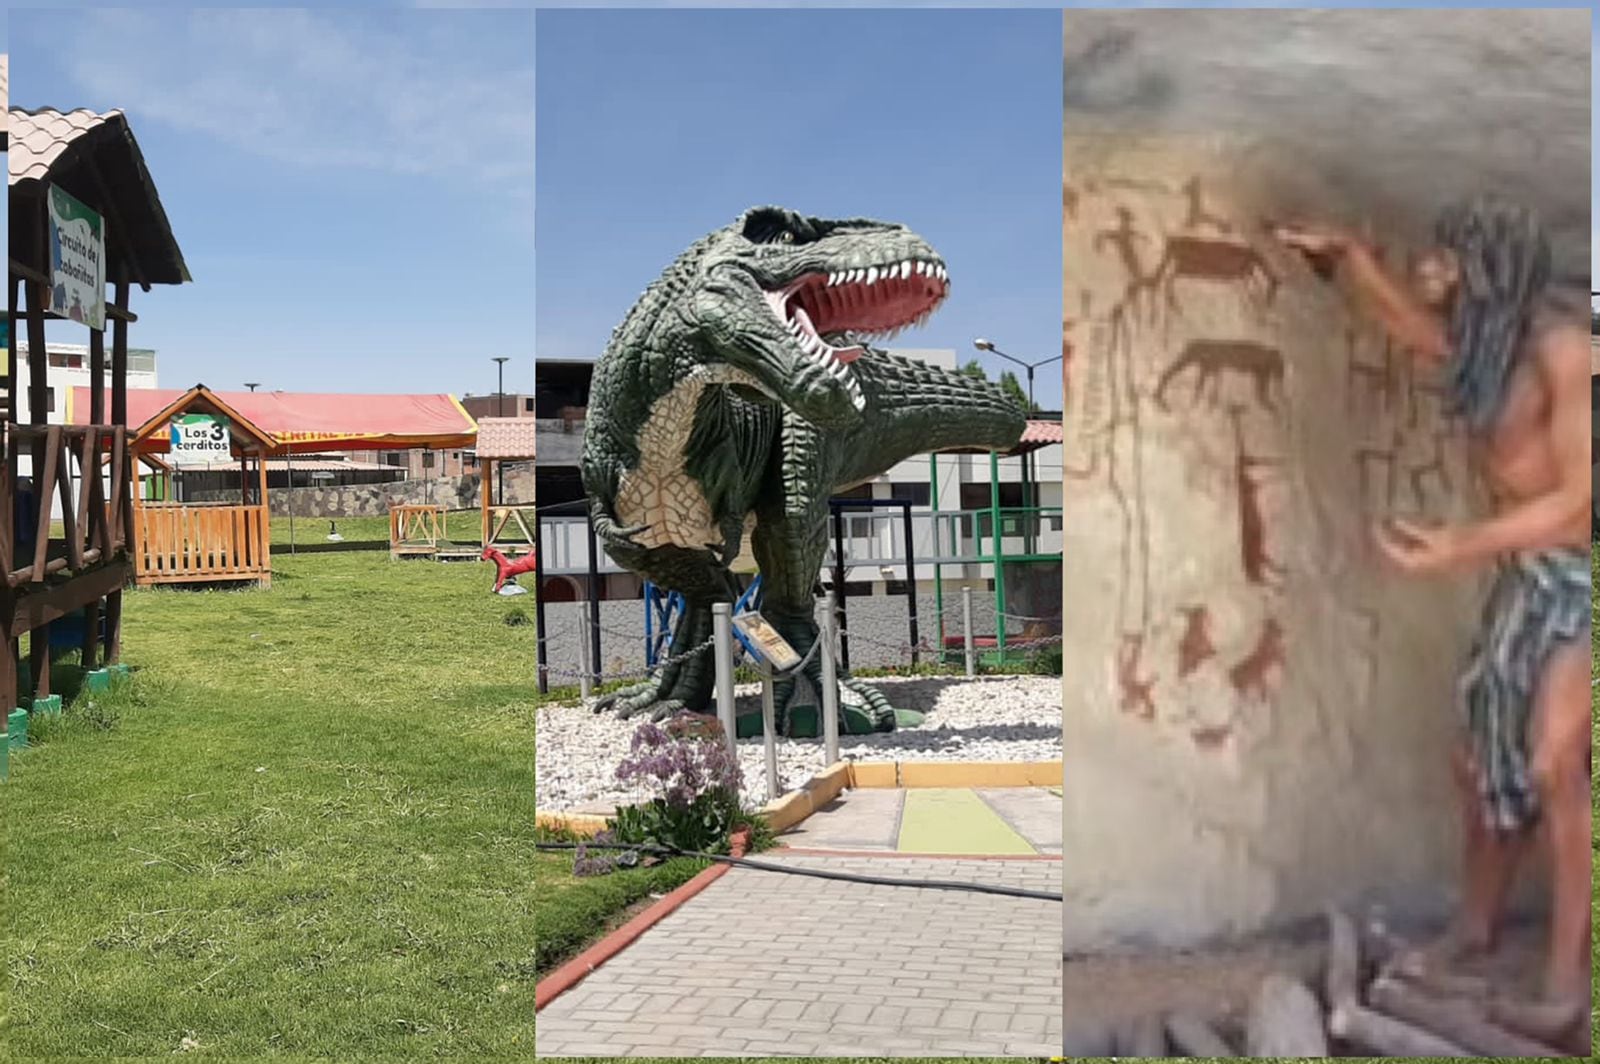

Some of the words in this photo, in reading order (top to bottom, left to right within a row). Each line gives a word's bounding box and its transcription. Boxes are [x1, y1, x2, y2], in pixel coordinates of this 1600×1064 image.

[57, 226, 87, 256] Circuito
[88, 245, 96, 263] de
[60, 258, 94, 287] cabañitas
[185, 427, 207, 438] Los
[210, 423, 225, 441] 3
[176, 440, 228, 450] cerditos
